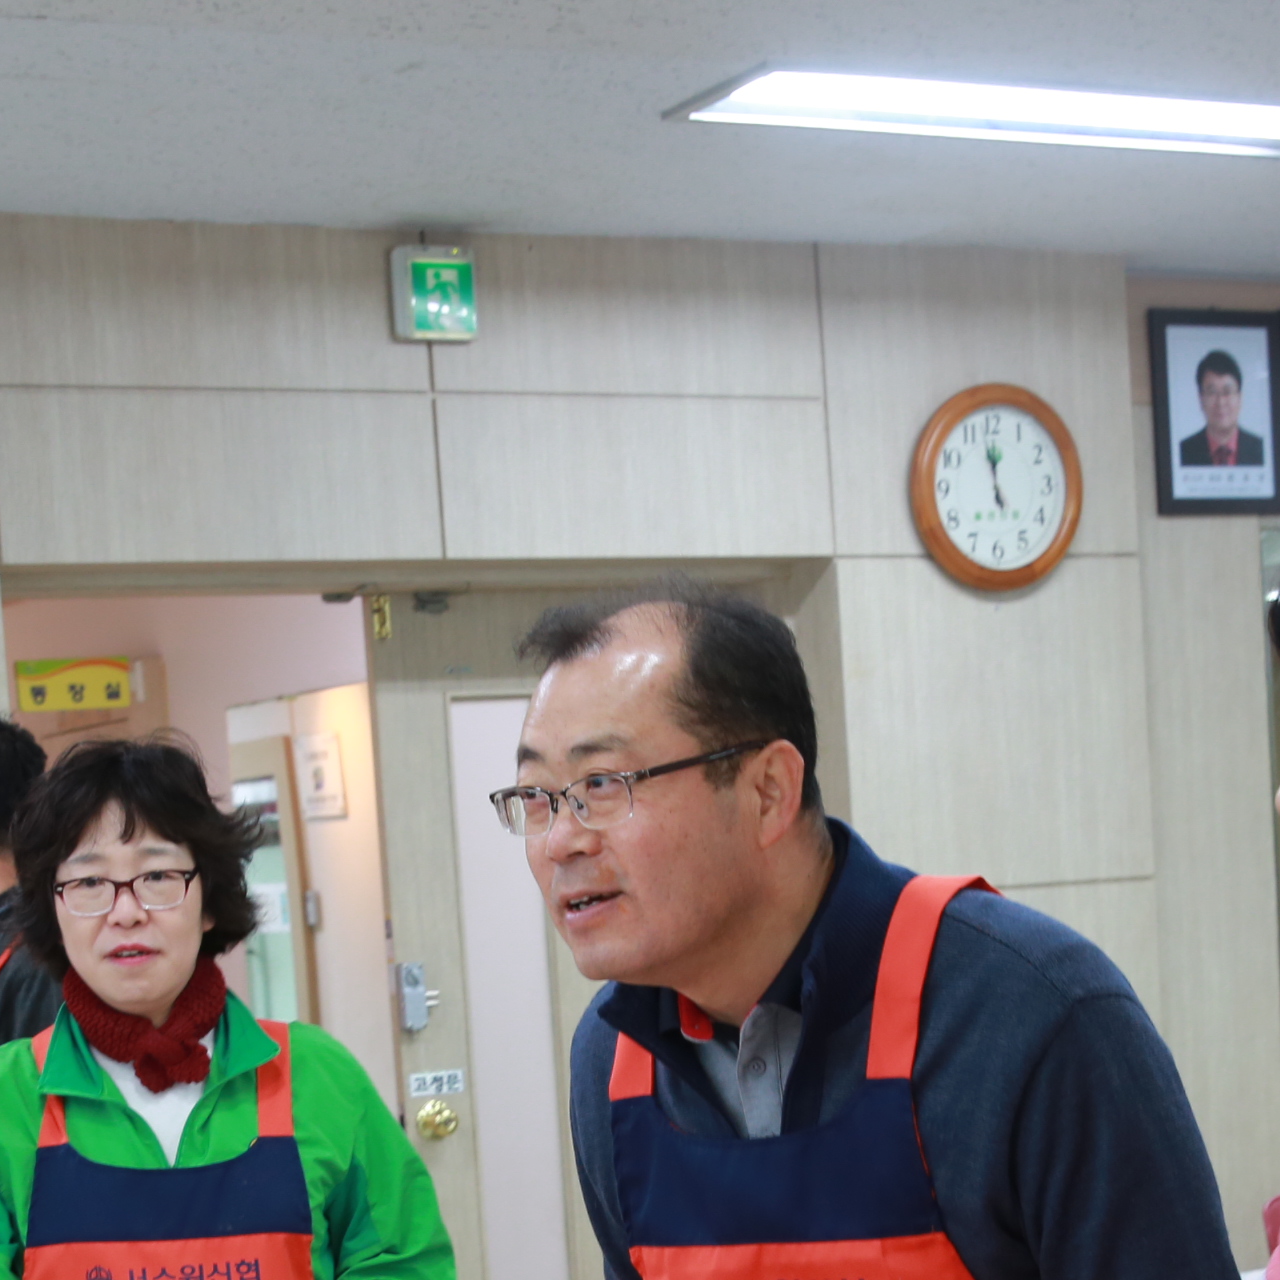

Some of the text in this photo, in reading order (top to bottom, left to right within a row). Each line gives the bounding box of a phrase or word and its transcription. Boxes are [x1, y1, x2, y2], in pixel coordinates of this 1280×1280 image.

[963, 424, 976, 444] 11
[985, 414, 1000, 435] 12
[942, 449, 961, 469] 10
[1033, 445, 1044, 465] 2
[937, 479, 950, 499] 9
[1040, 475, 1053, 495] 3
[946, 509, 960, 529] 8
[1033, 506, 1045, 526] 4
[967, 532, 978, 553] 7
[992, 539, 1004, 560] 6
[1017, 530, 1028, 549] 5
